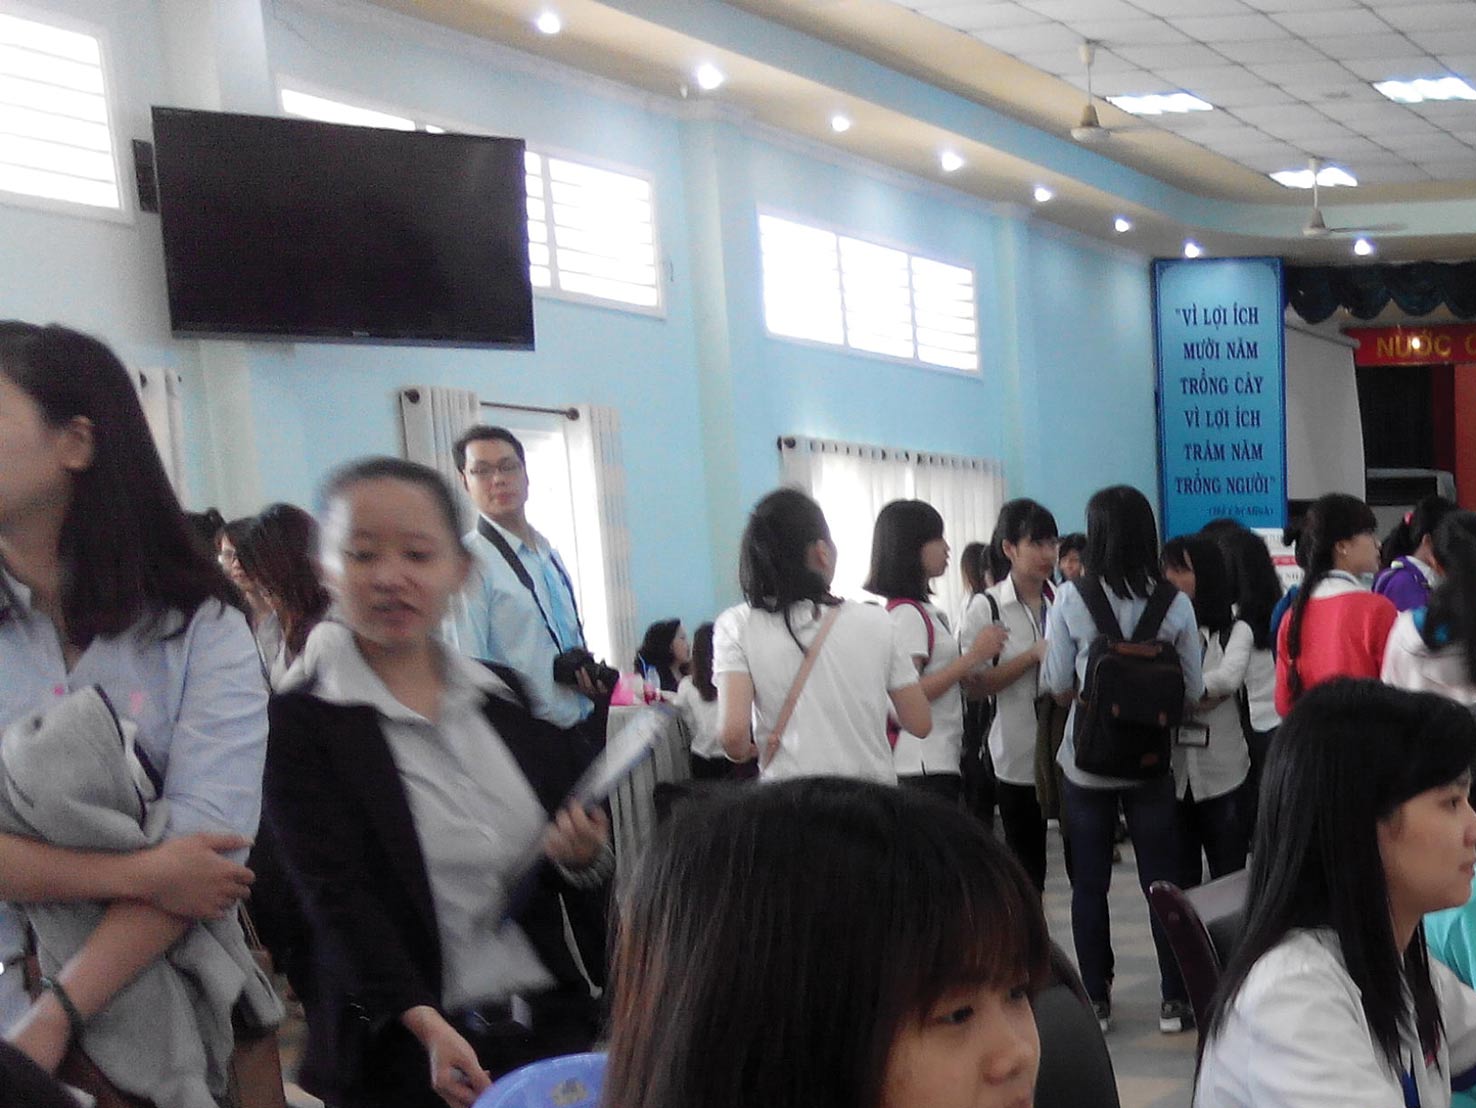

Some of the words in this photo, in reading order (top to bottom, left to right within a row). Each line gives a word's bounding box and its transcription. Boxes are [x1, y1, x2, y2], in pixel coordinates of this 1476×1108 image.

[1203, 308, 1228, 331] LỢI
[1233, 302, 1259, 326] ÍCH
[1183, 340, 1221, 360] MƯỜI
[1227, 337, 1259, 360] NĂM
[1376, 328, 1451, 357] NƯỚC
[1180, 368, 1229, 396] TRỒNG
[1235, 371, 1264, 395] CÂY
[1206, 409, 1230, 432] LỢI
[1235, 405, 1261, 429] ÍCH
[1184, 440, 1226, 462] TRĂM
[1231, 439, 1264, 462] NĂM
[1175, 468, 1222, 495] TRỒNG
